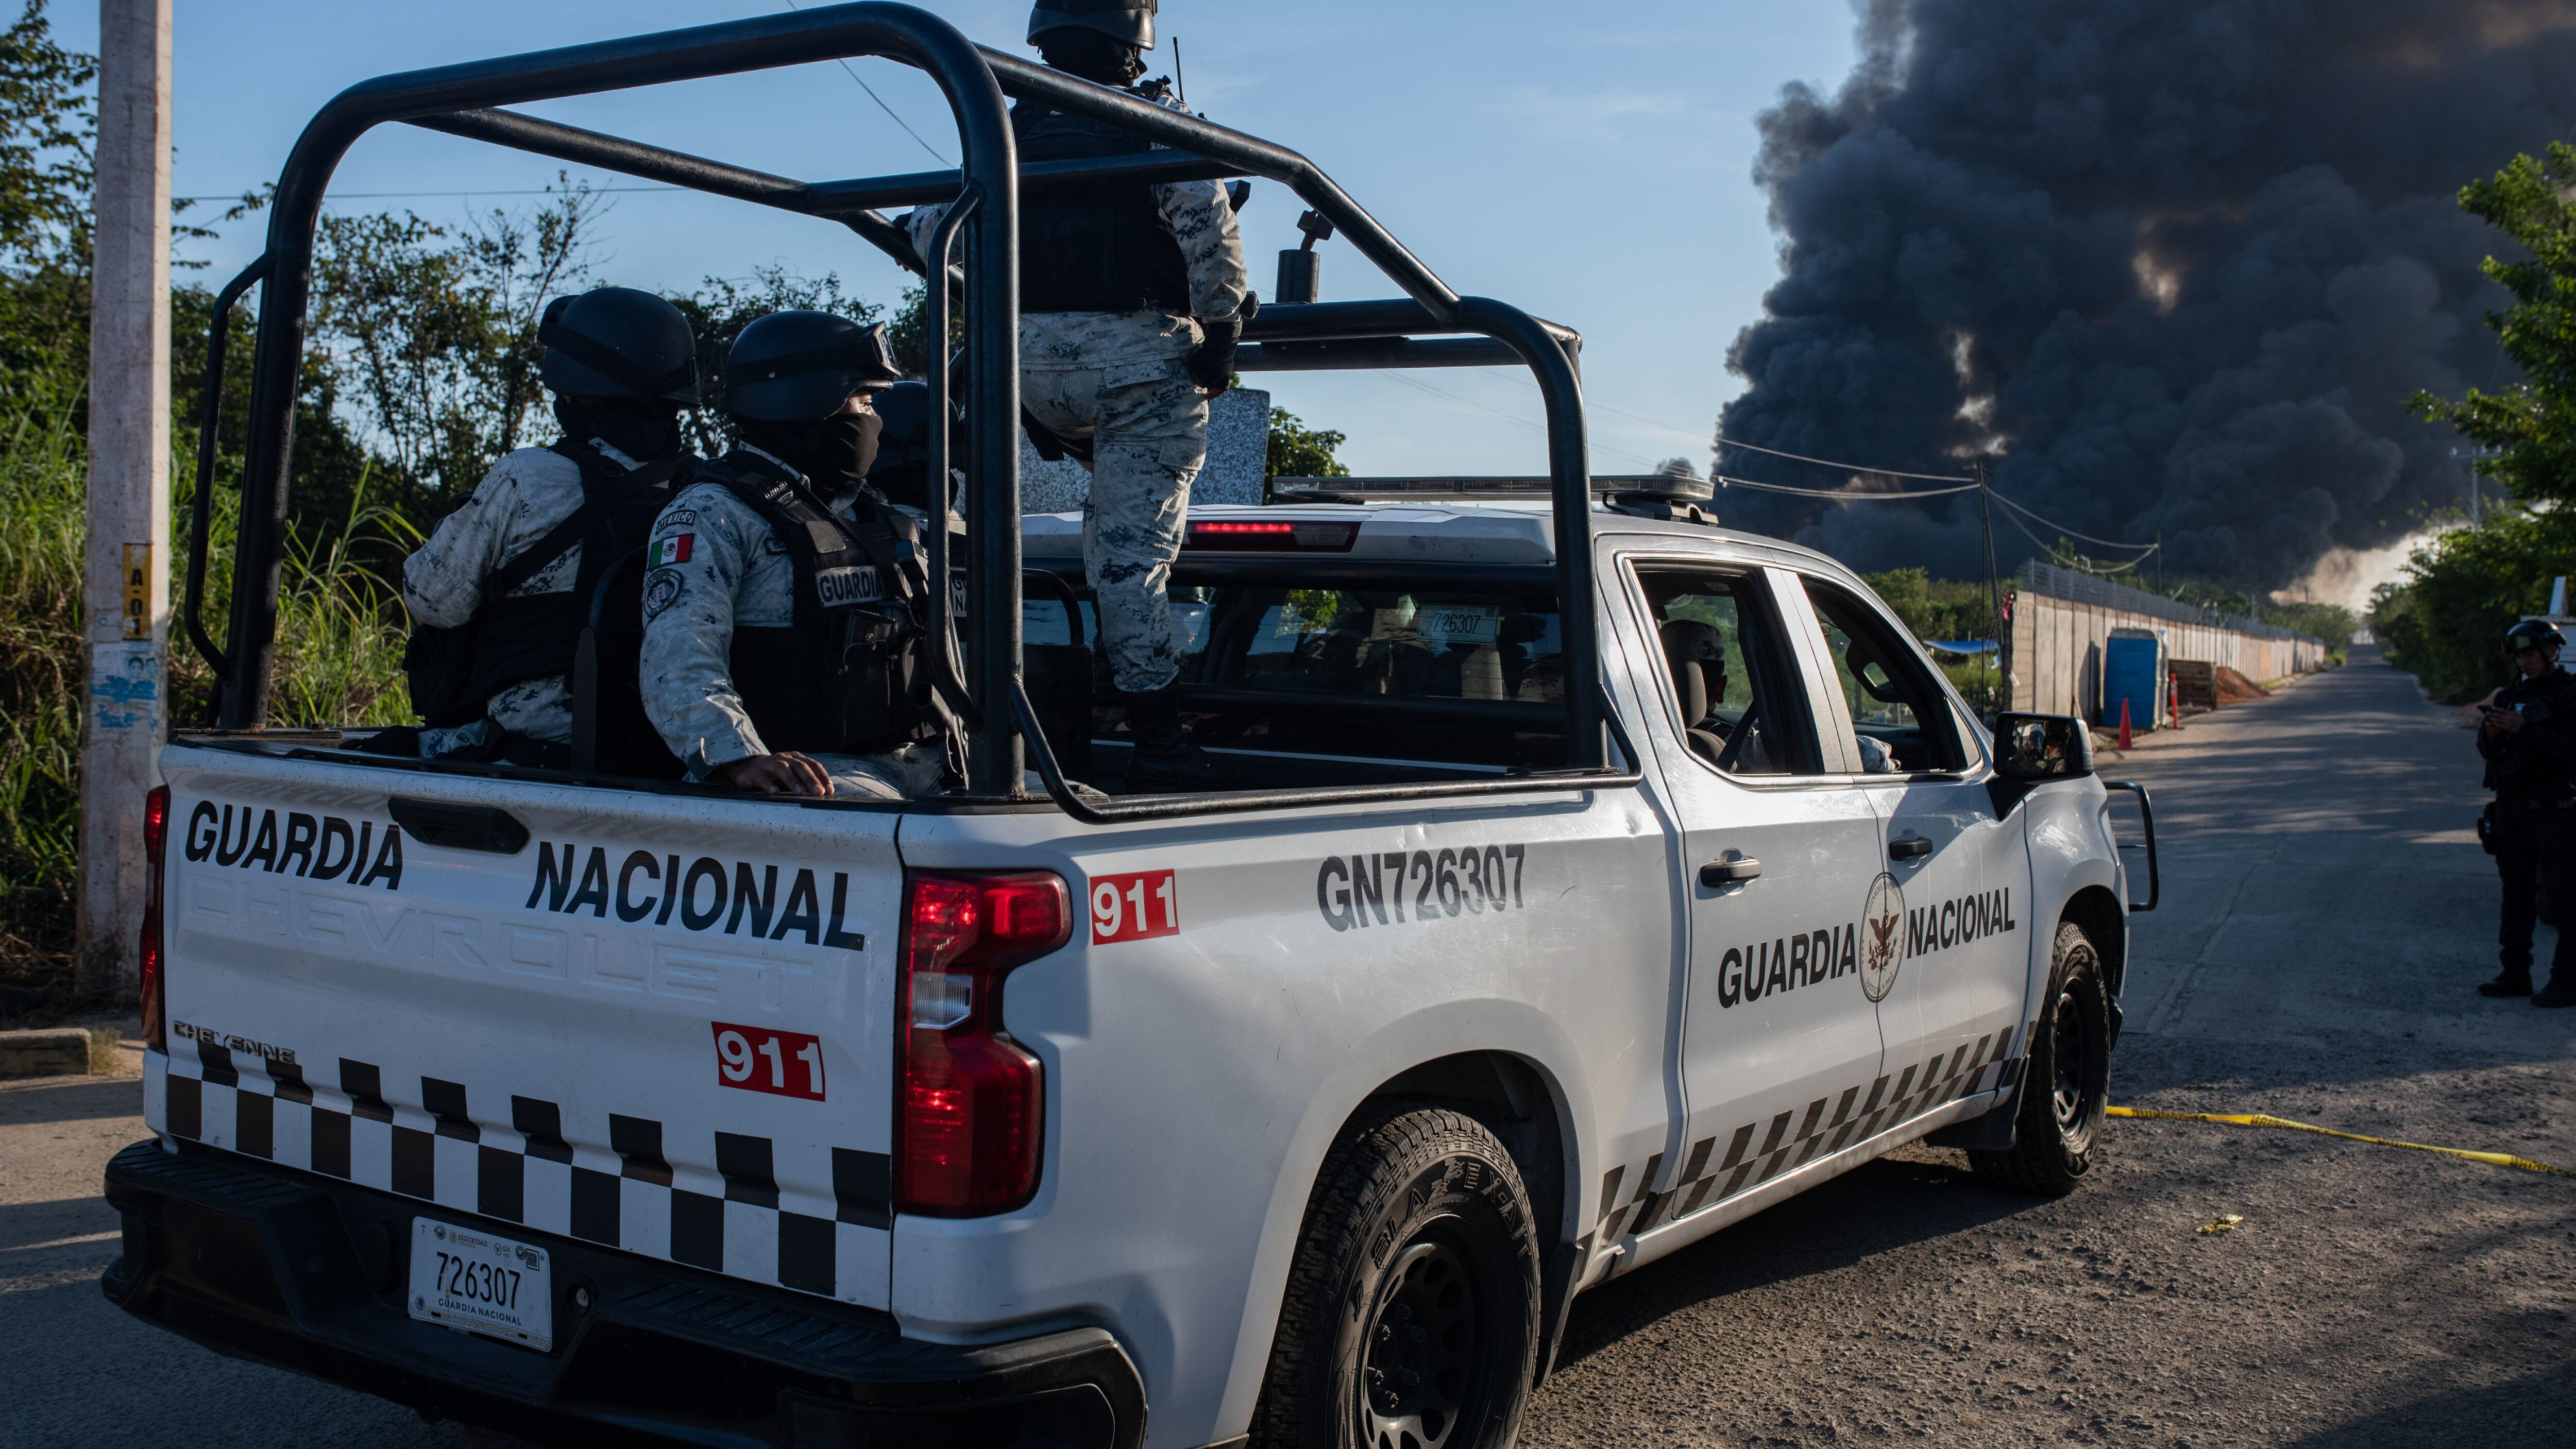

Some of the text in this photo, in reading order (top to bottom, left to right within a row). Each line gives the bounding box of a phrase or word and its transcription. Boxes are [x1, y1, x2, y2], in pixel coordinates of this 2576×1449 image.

[659, 511, 692, 530] MEXICO
[819, 571, 883, 603] GUARDIA
[1434, 612, 1481, 634] 726307
[185, 800, 866, 951] GUARDIA NACIONAL
[1317, 843, 1526, 932] GN726307
[1092, 876, 1177, 937] 911
[1868, 883, 1883, 914] GUARDIA
[188, 875, 814, 1012] CHEVROLET
[1718, 887, 2015, 1009] GUARDIA NACIONAL
[1865, 977, 1881, 995] JUSTICA
[173, 1020, 296, 1065] CHEYENNE
[718, 1031, 823, 1094] 911
[457, 1234, 488, 1247] SEGURIDAD
[502, 1245, 511, 1254] GN
[436, 1251, 521, 1309] 726307
[438, 1298, 522, 1326] GUARDIA NACIONAL
